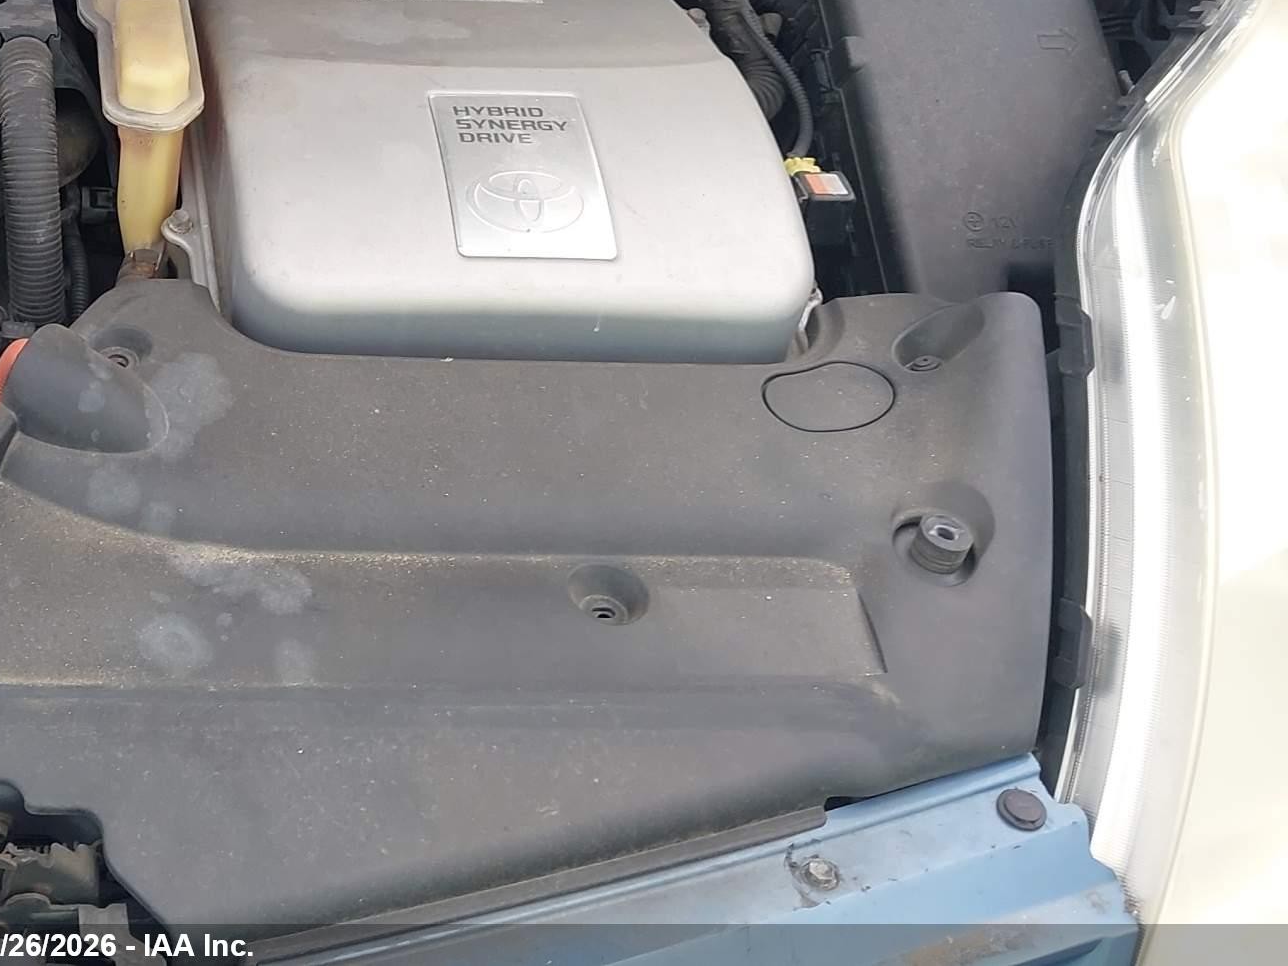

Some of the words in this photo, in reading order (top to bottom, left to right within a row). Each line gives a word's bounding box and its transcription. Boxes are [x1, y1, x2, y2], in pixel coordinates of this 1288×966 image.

[452, 106, 544, 118] HYBRID
[455, 119, 568, 132] SYNERGY
[458, 132, 533, 144] DRIVE
